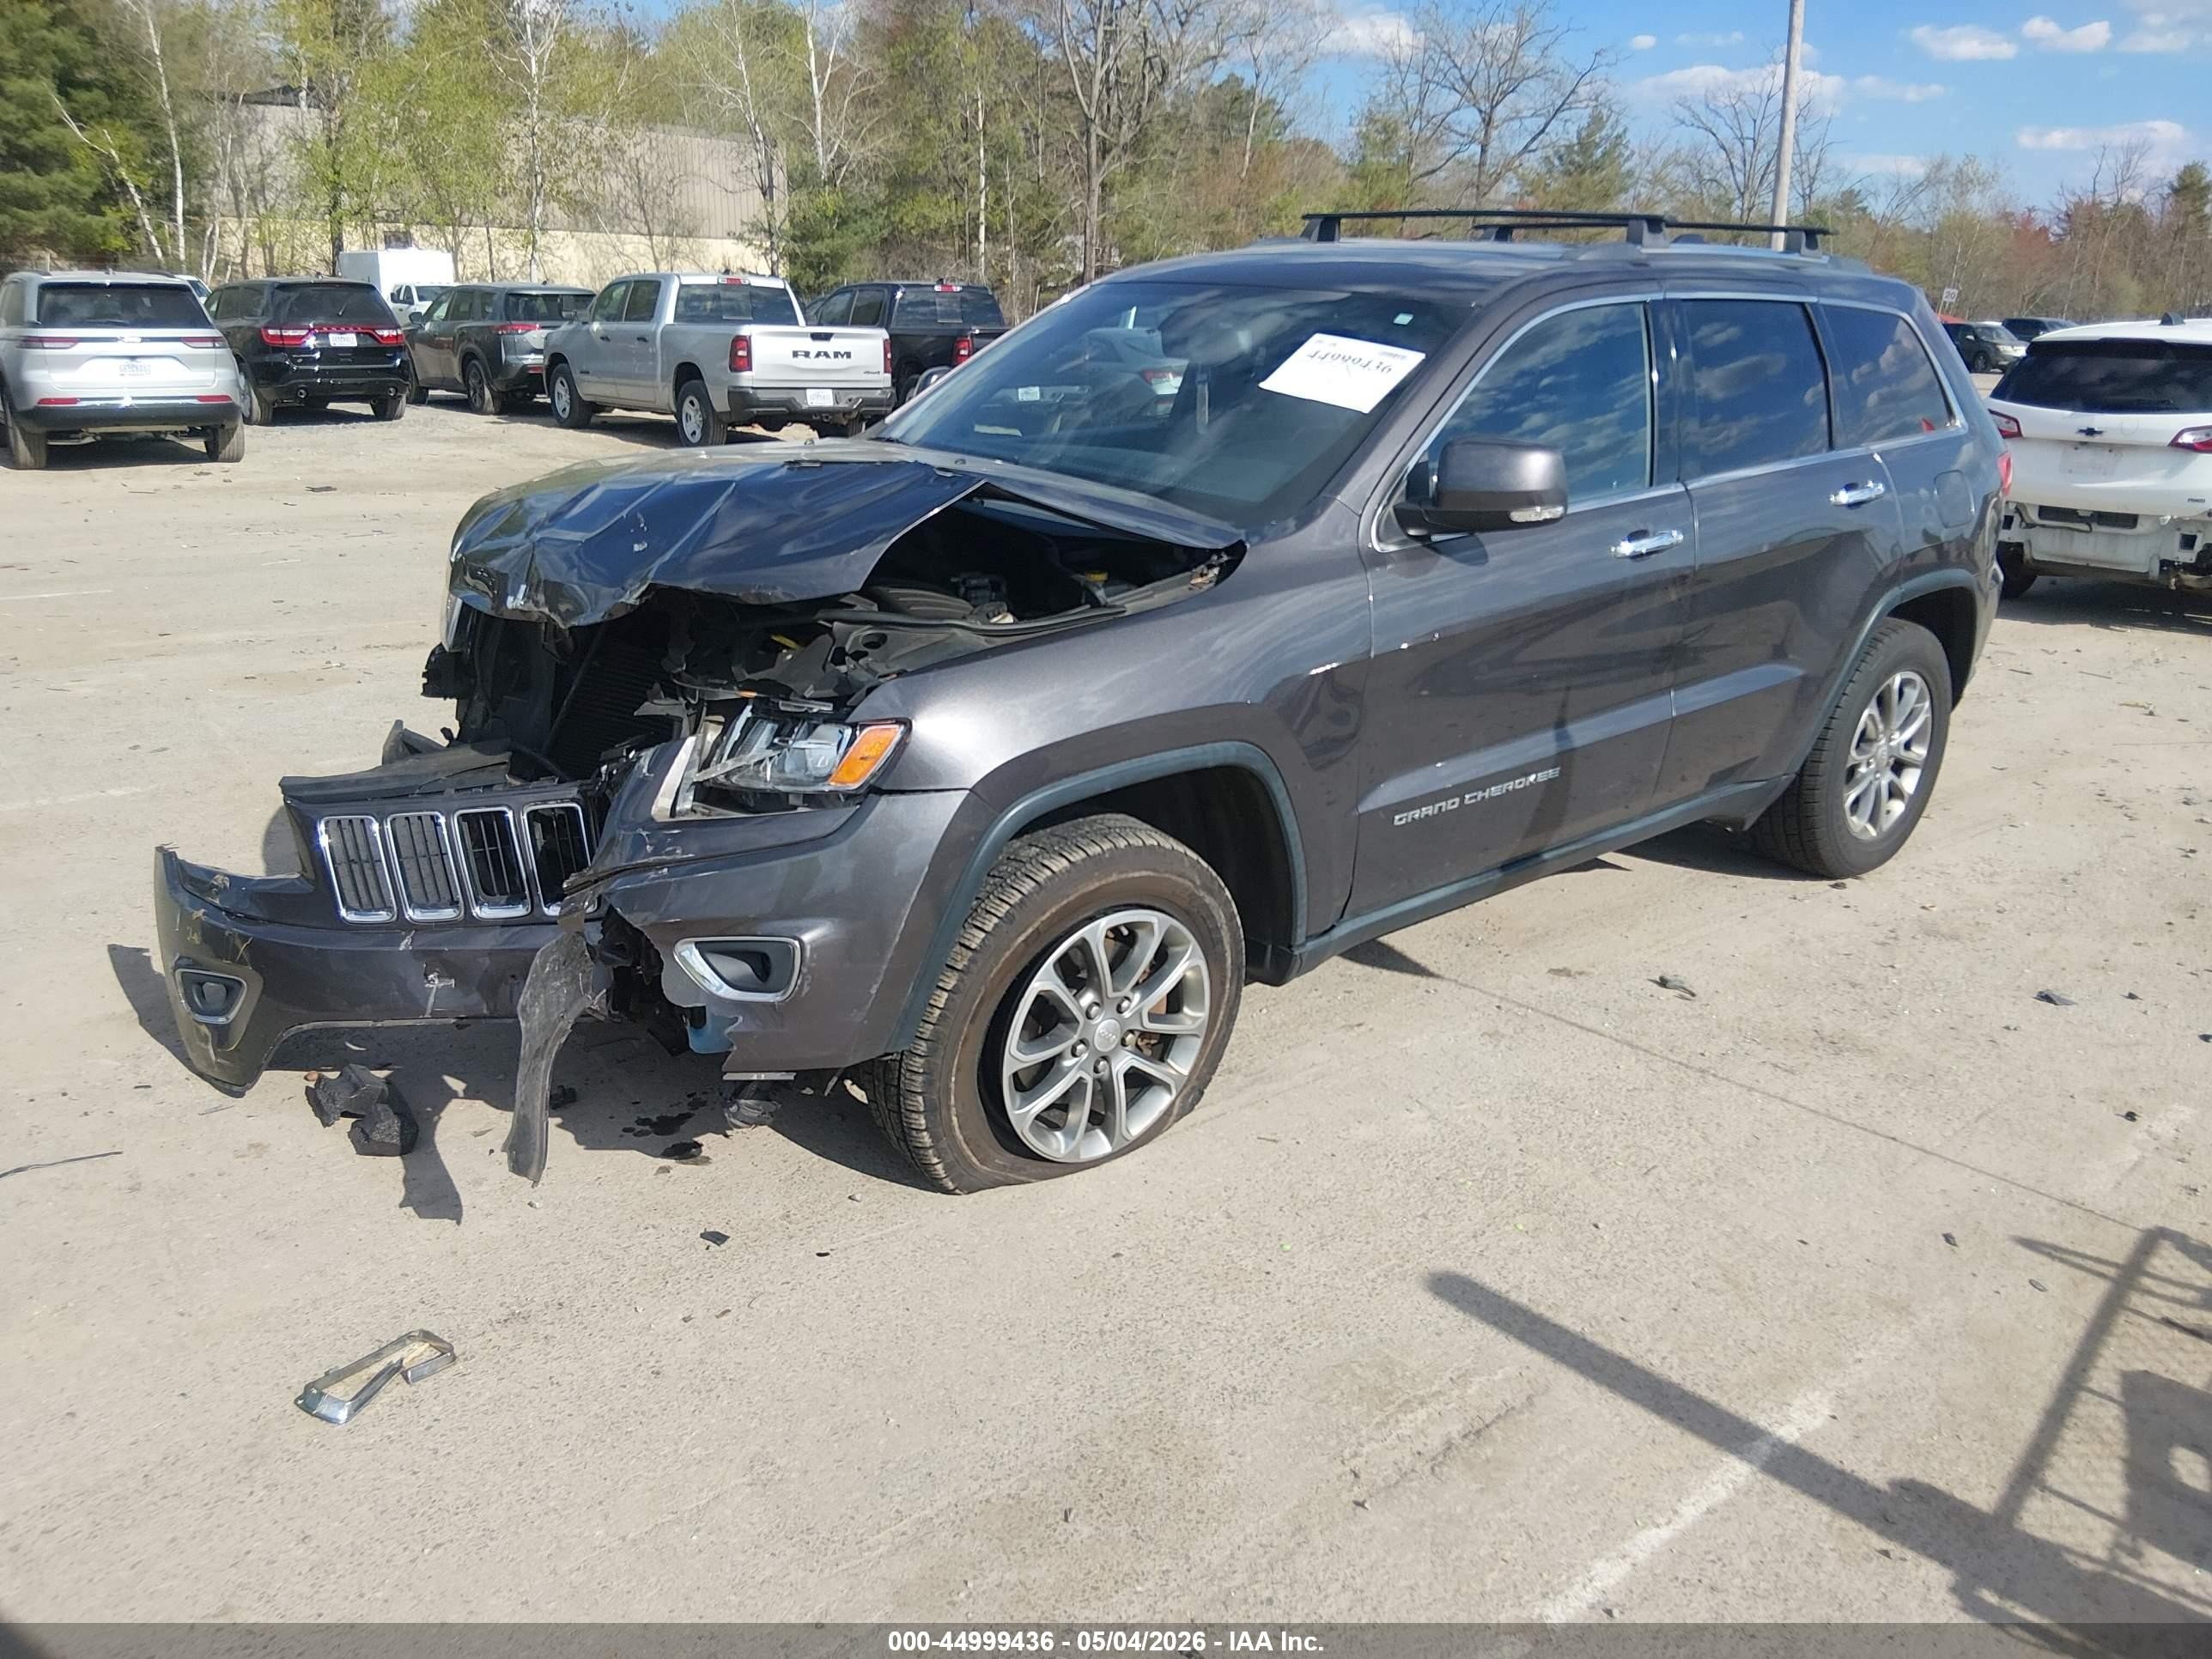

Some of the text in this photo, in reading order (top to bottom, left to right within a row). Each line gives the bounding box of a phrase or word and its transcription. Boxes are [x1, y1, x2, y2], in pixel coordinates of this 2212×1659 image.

[1945, 290, 1956, 300] 20
[792, 350, 852, 359] RAM
[1394, 767, 1560, 826] GRAND CHEROKEE
